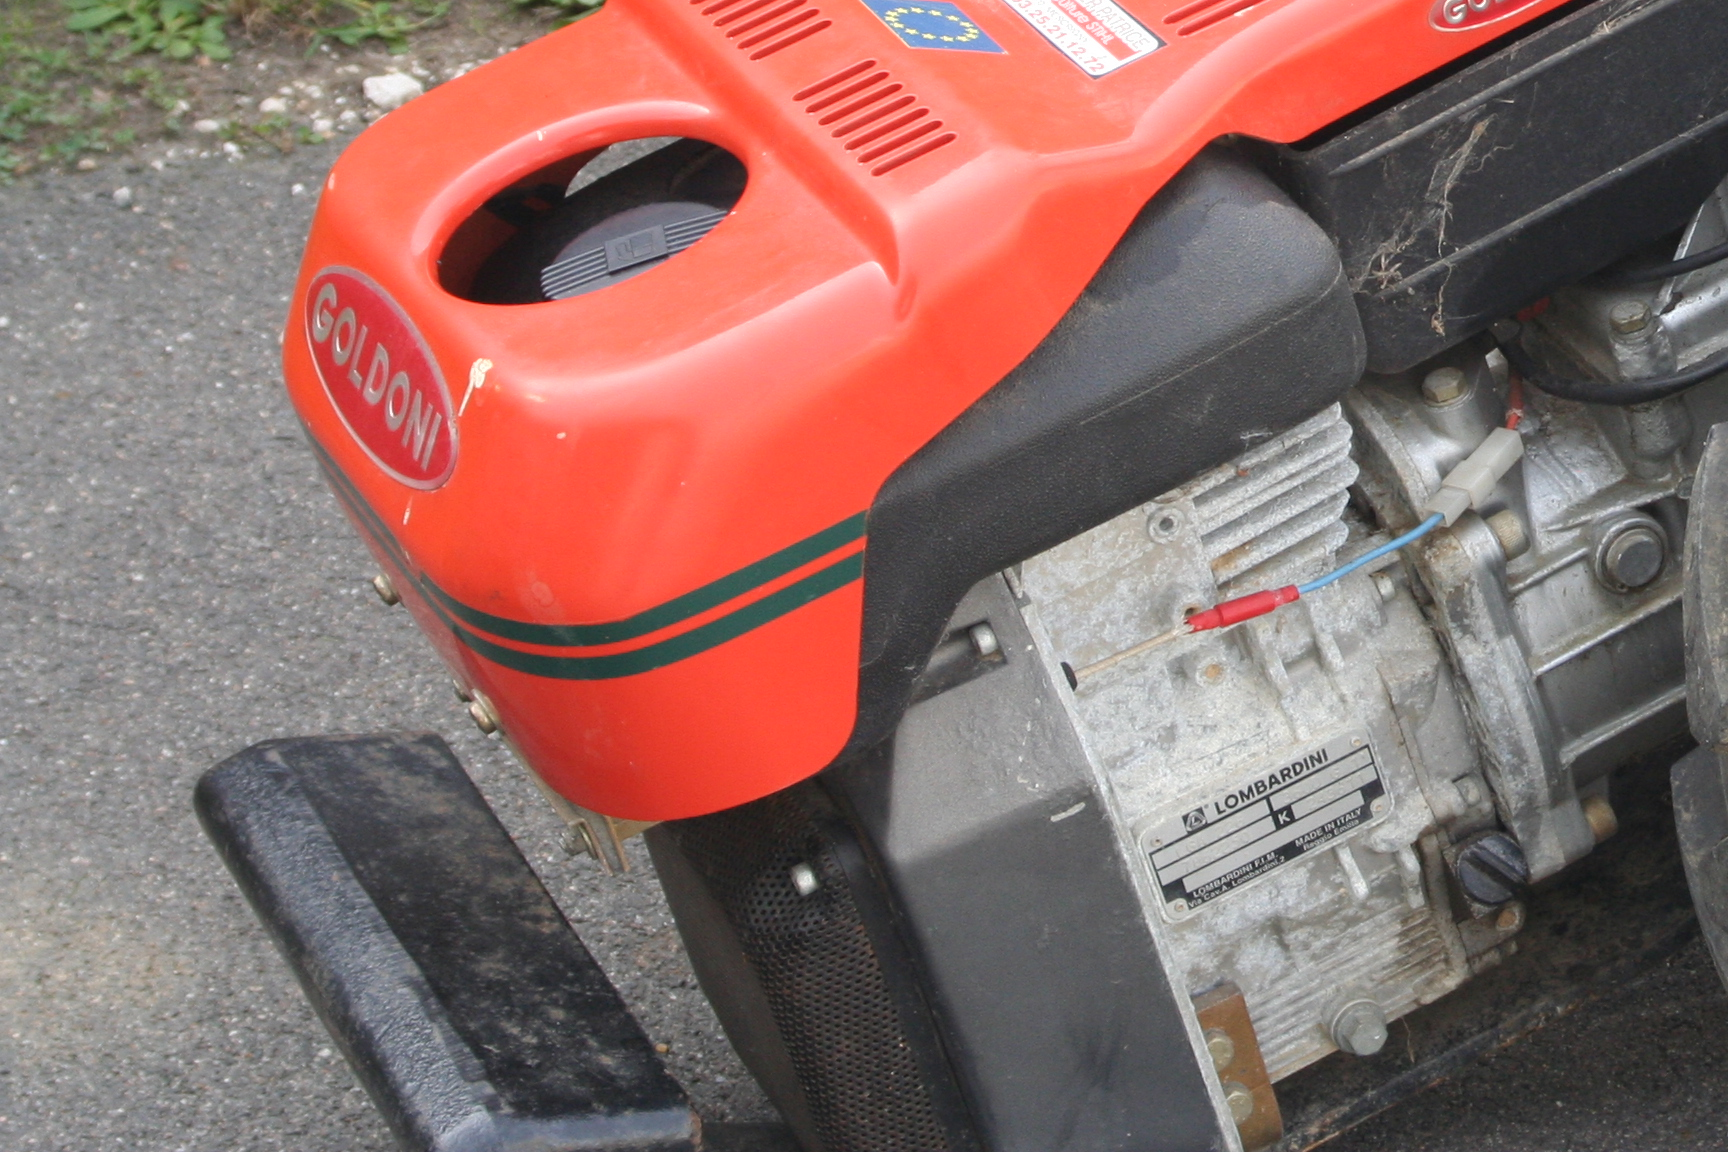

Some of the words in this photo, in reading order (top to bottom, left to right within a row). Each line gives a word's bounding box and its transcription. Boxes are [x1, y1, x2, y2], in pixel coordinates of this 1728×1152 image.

[1083, 20, 1117, 45] STIHL
[1093, 5, 1151, 49] PATRICE
[312, 283, 442, 471] GOLDONI
[1214, 749, 1329, 814] LOMBARDINI
[1277, 810, 1290, 824] K
[1294, 827, 1324, 847] MADE
[1323, 821, 1335, 832] IN
[1335, 806, 1364, 827] ITALY
[1302, 831, 1332, 851] Reggio
[1333, 817, 1359, 835] Emilia
[1192, 863, 1252, 899] LOMBARDINI
[1188, 897, 1202, 909] Via
